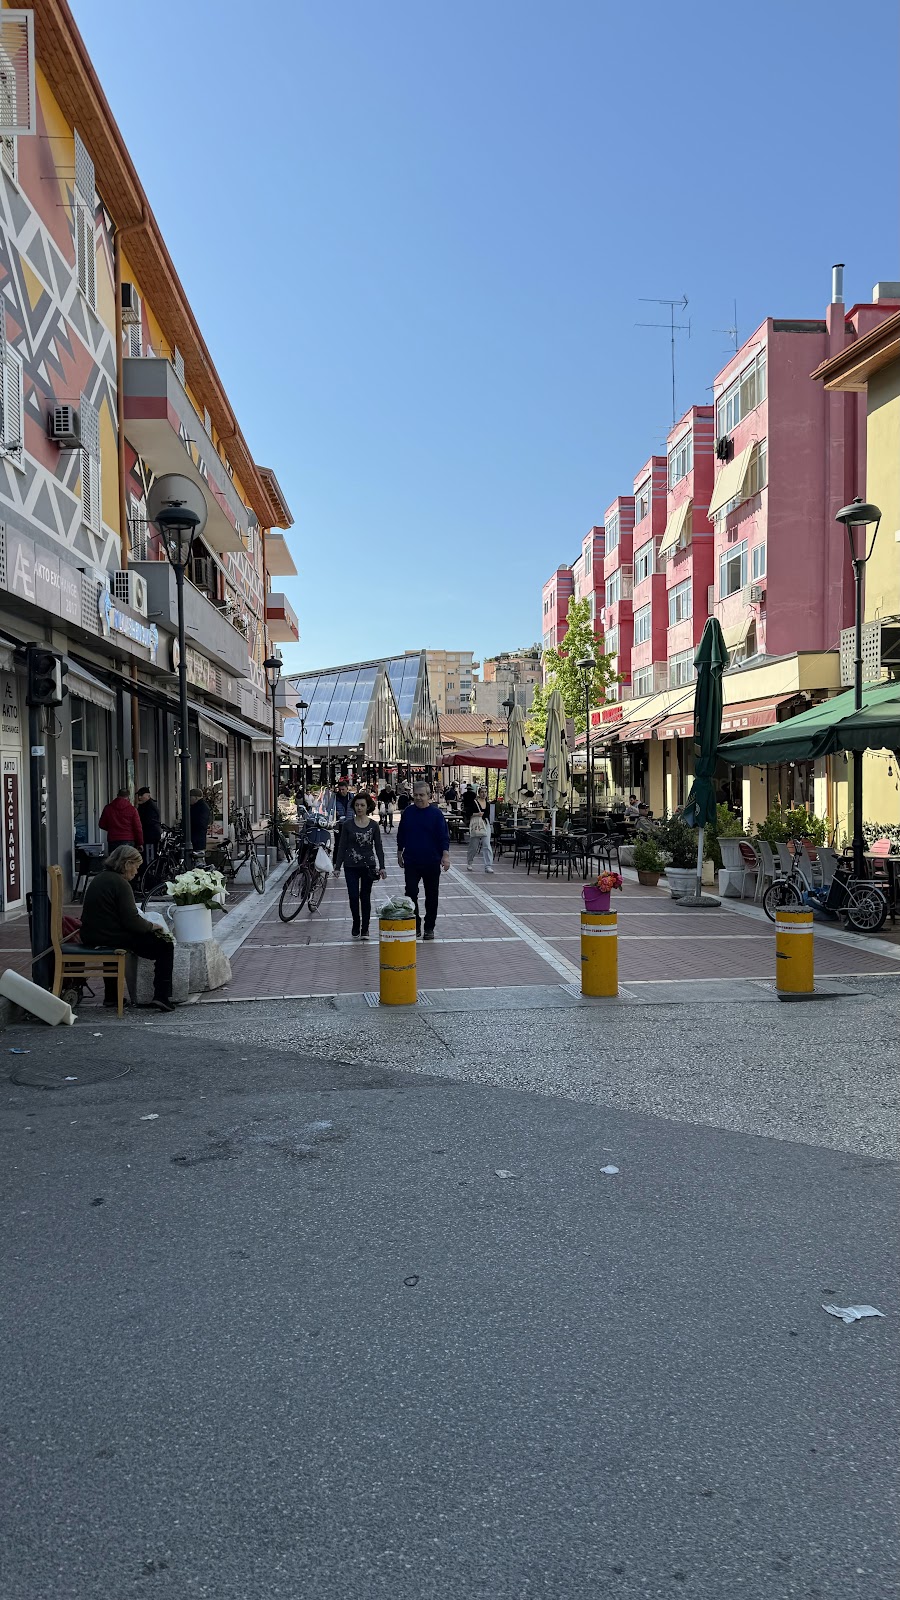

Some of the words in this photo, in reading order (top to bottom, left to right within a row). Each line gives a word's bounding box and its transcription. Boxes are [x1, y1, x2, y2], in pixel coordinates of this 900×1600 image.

[33, 560, 50, 583] AKTO
[50, 570, 78, 599] EXCHANGE
[65, 598, 78, 616] 2017
[2, 703, 18, 719] AKTO
[2, 723, 19, 734] EXCHANGE
[4, 761, 16, 771] AKTO
[7, 777, 16, 886] EXCHANGE
